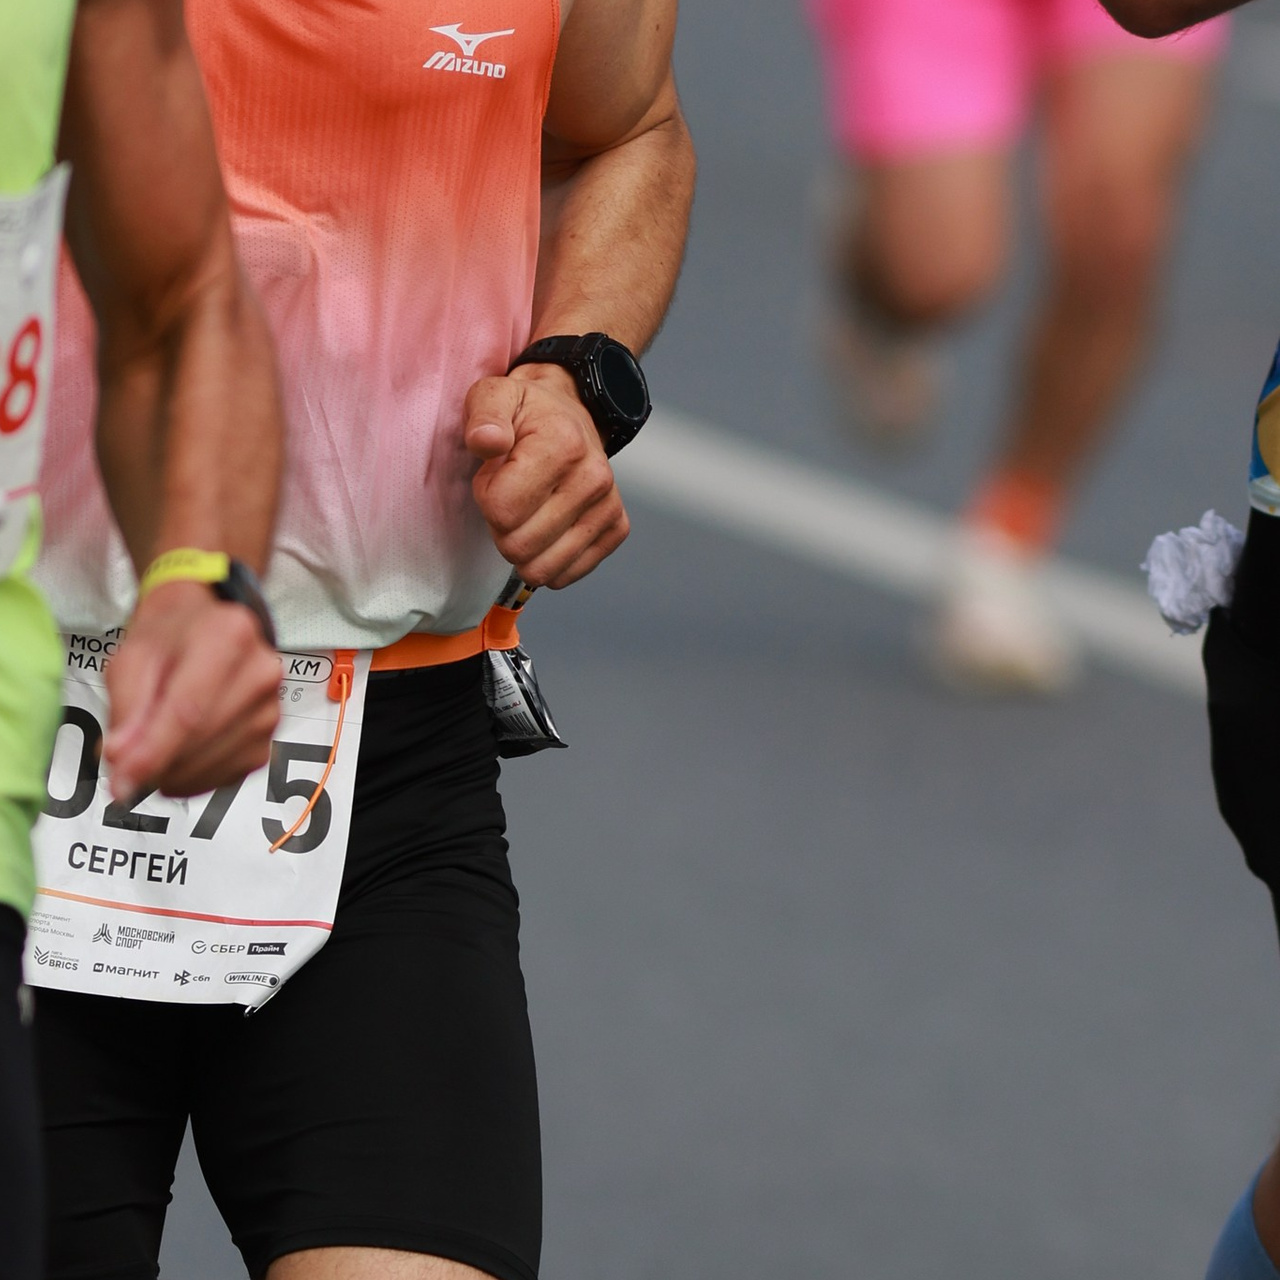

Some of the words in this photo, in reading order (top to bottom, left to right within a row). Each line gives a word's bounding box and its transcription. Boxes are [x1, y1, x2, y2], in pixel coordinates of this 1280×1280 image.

[71, 634, 120, 656] МОС
[67, 842, 188, 885] СЕРГЕЙ
[117, 925, 175, 944] МОСКОВСКИЙ
[115, 937, 143, 950] СПОРТ
[210, 944, 245, 953] СБЕР
[251, 945, 280, 953] Прайм
[49, 959, 78, 971] BRICS
[228, 974, 268, 984] WINLINE
